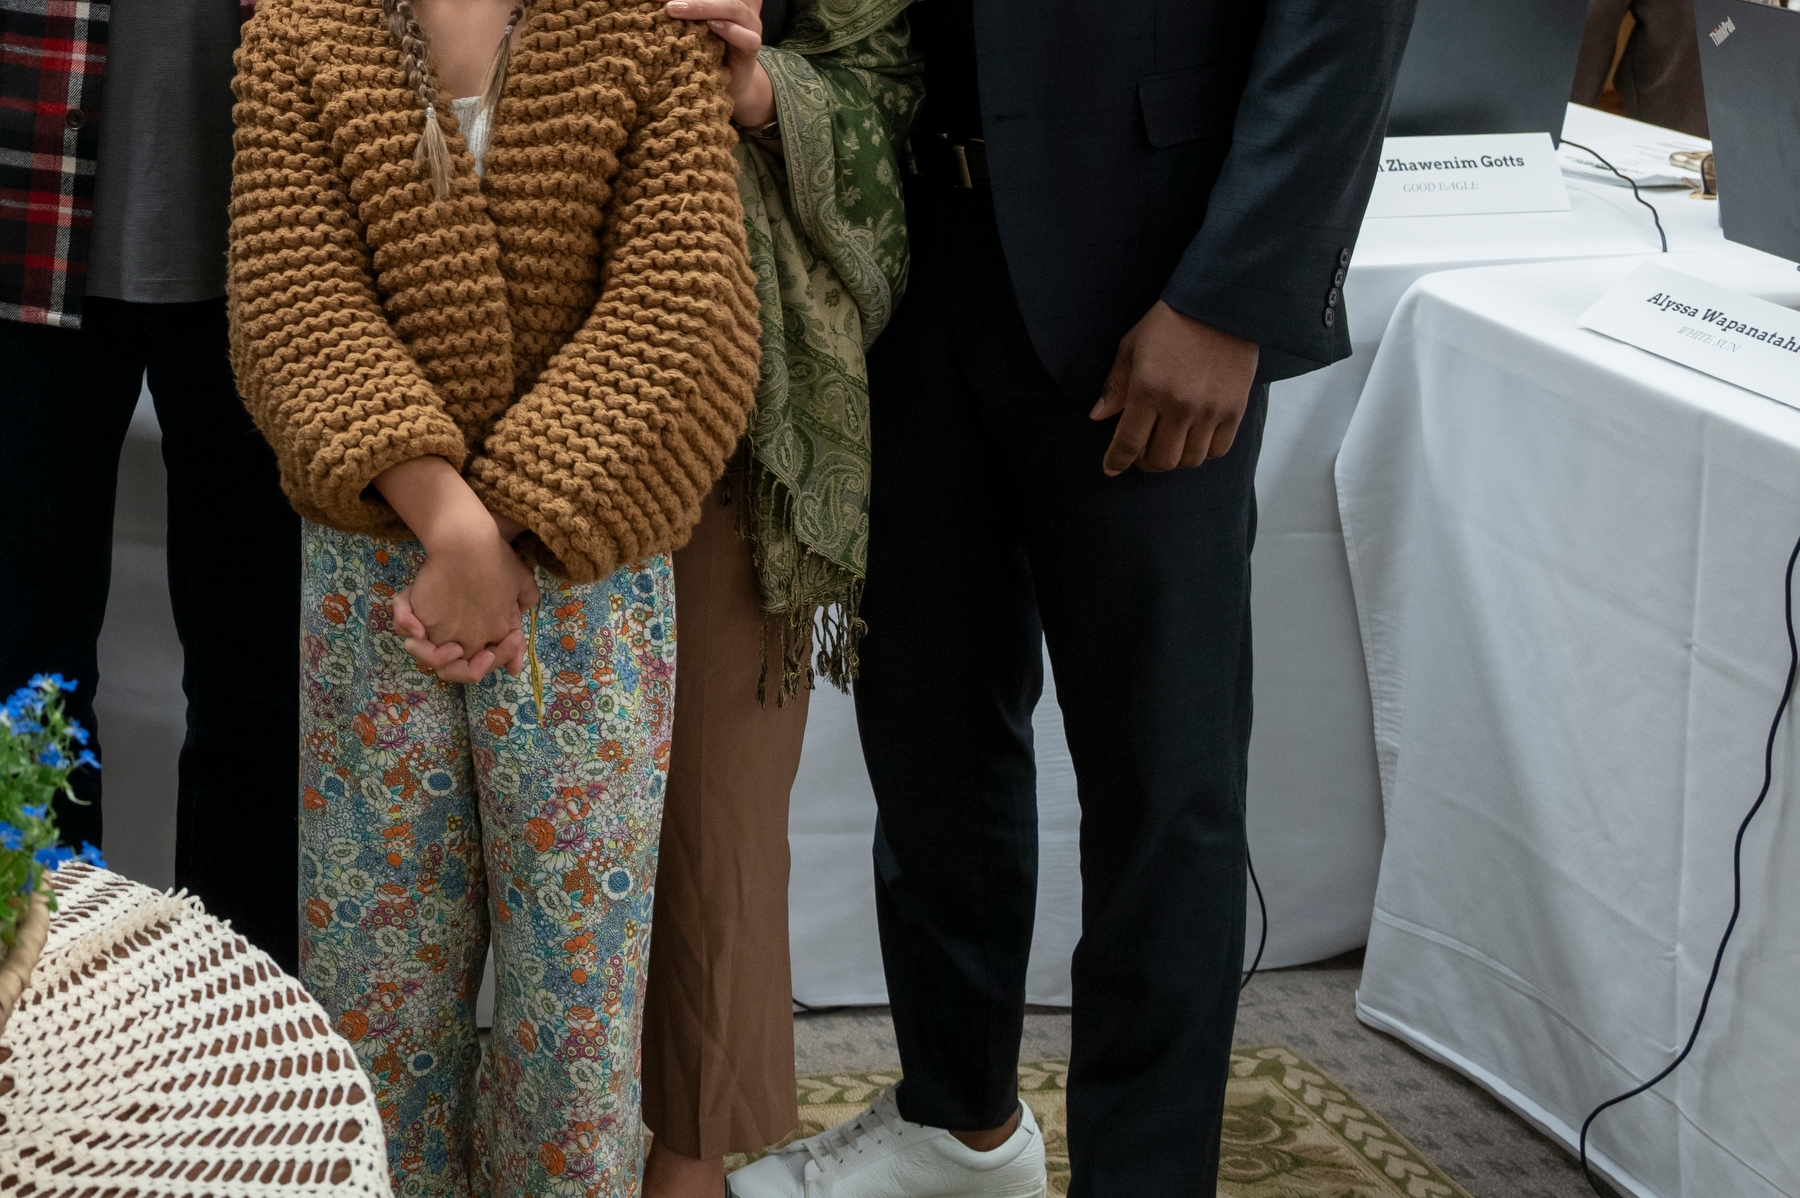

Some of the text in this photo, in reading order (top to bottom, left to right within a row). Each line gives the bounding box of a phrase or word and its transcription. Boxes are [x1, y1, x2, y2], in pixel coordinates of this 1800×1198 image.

[1386, 156, 1478, 172] Zhawenim
[1480, 155, 1525, 168] Gotts
[1403, 180, 1479, 193] GOOD EAGLE
[1647, 292, 1699, 317] Alyssa
[1677, 326, 1741, 353] WHITE SUN
